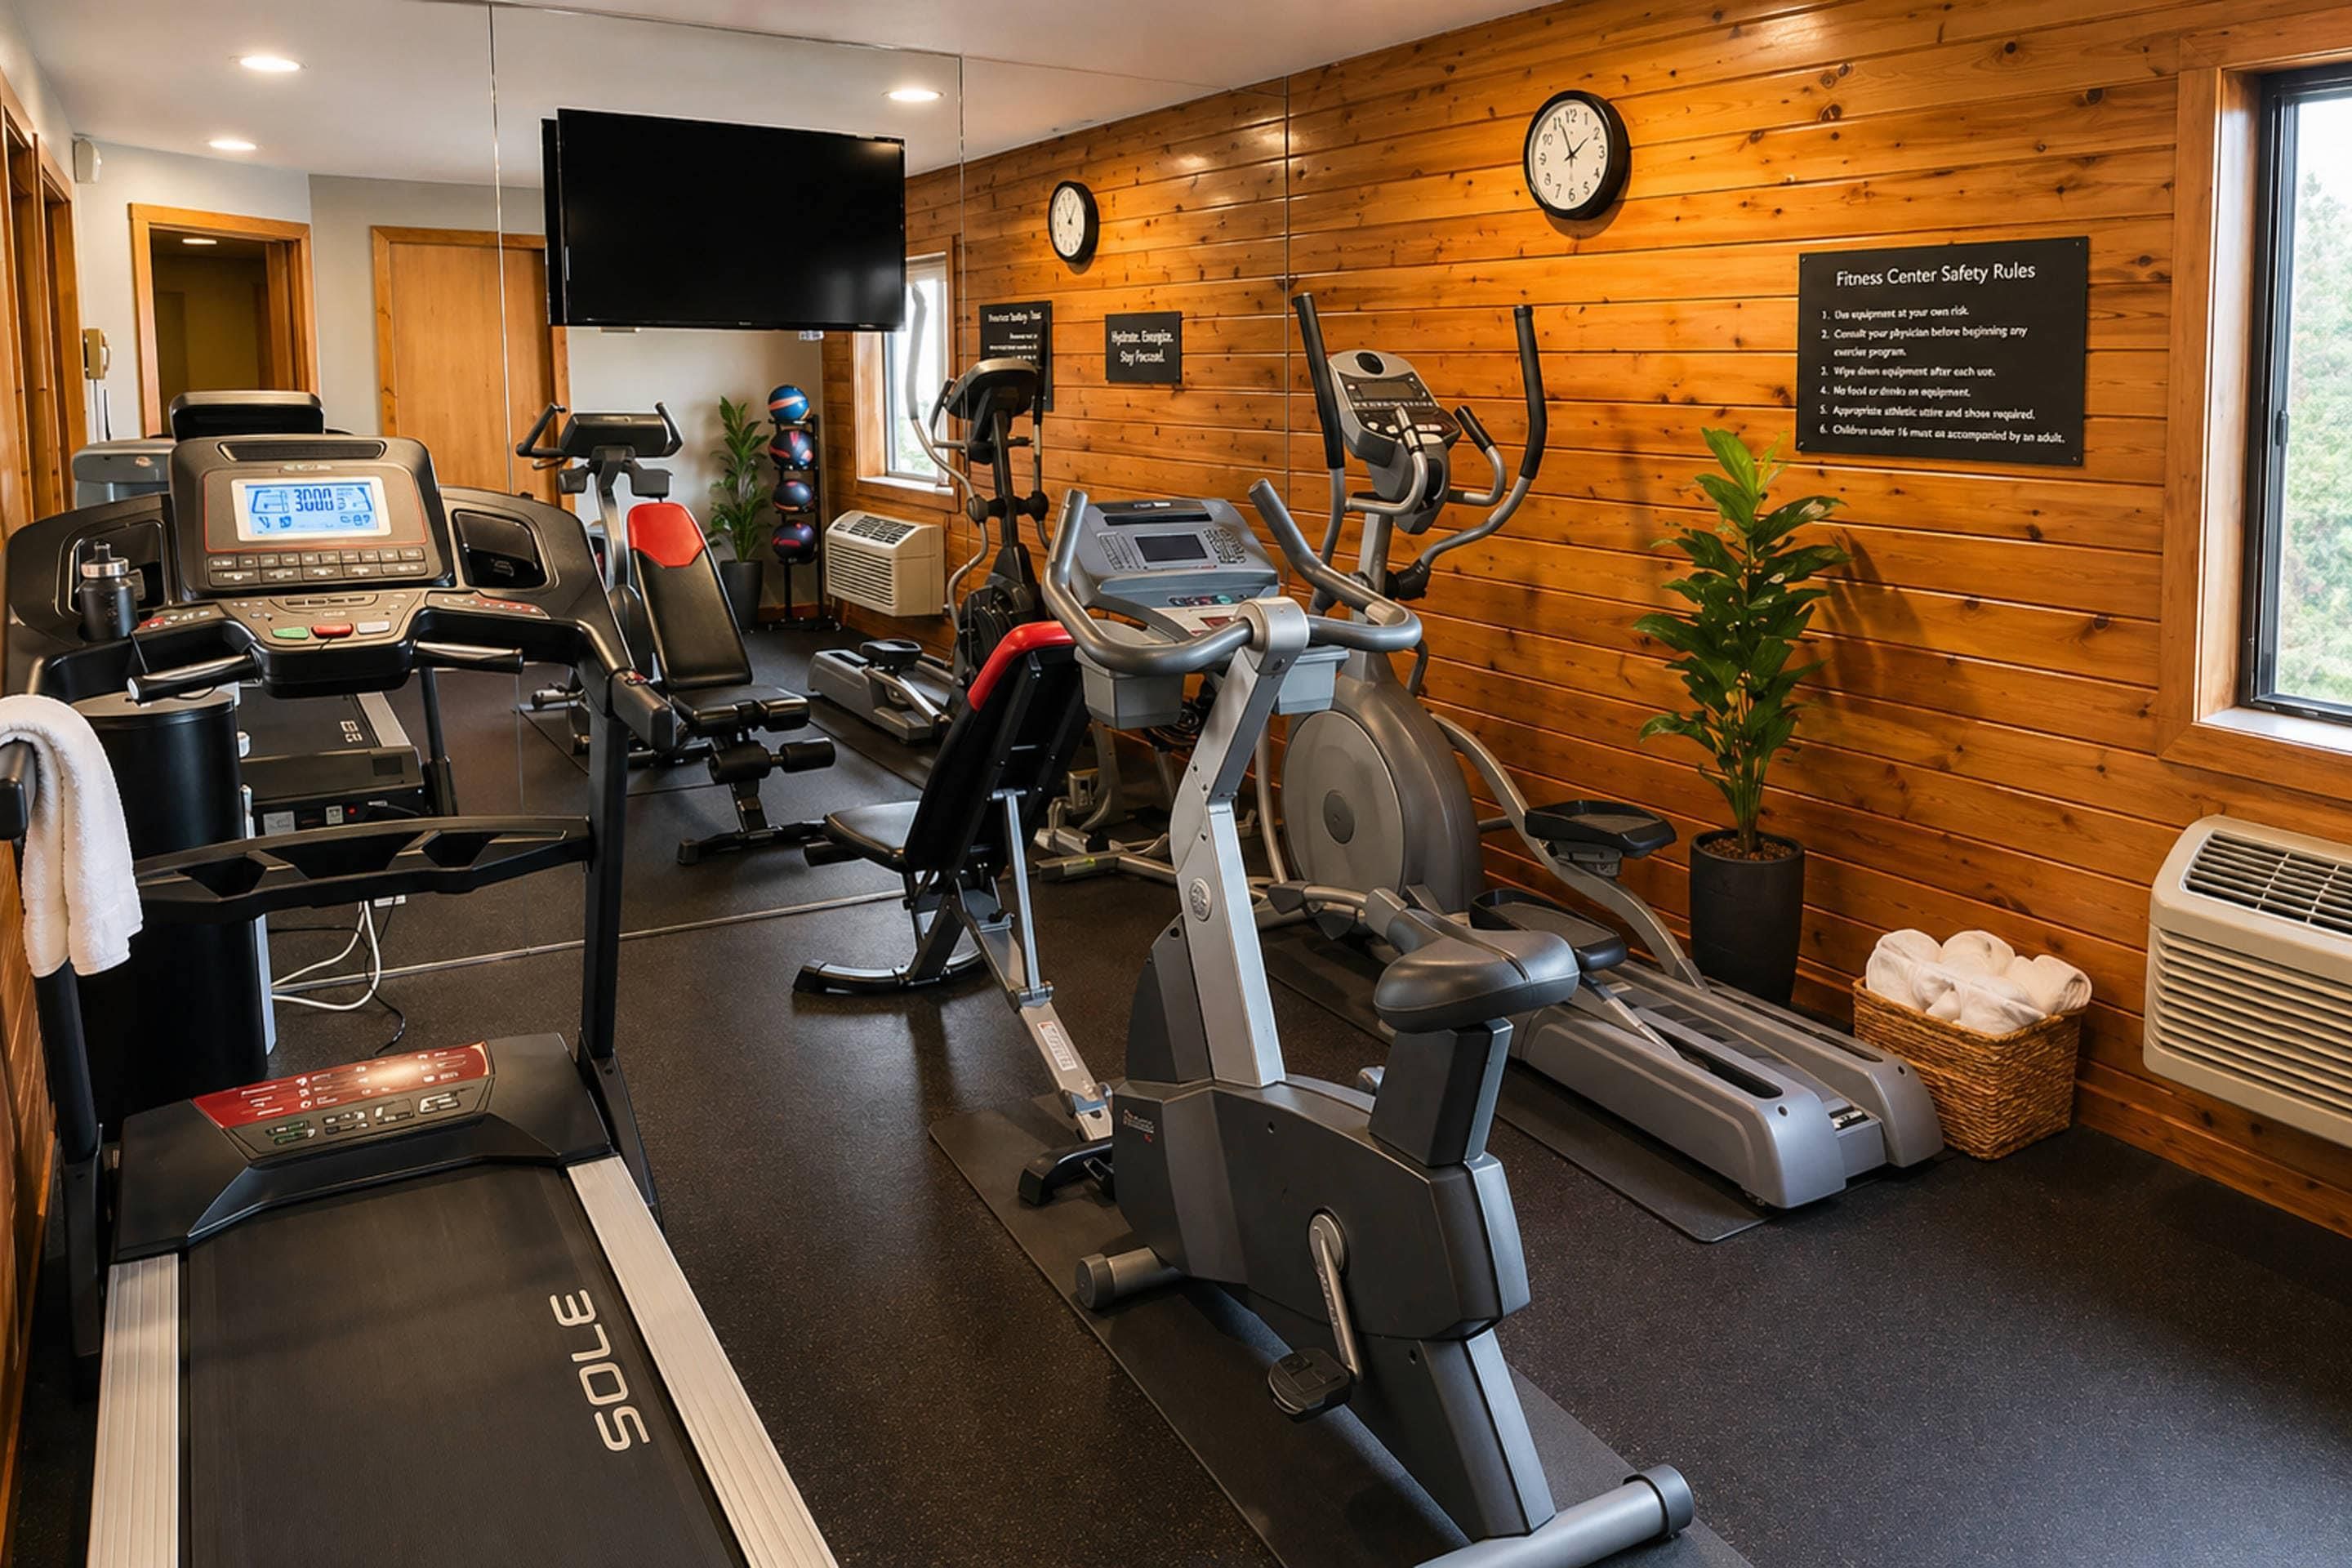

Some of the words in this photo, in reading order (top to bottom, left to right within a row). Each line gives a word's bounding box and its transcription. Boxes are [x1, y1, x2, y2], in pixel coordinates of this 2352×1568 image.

[1566, 109, 1577, 123] 12
[1584, 113, 1588, 125] 1
[1553, 117, 1561, 131] 11
[1593, 127, 1600, 140] 2
[1598, 145, 1606, 158] 3
[1539, 153, 1547, 165] 9
[1555, 184, 1561, 198] 7
[1569, 188, 1575, 202] 6
[1583, 181, 1590, 195] 5
[1837, 271, 1883, 286] Fitness
[1887, 268, 1937, 283] Center
[1941, 264, 1989, 284] Safety
[1993, 261, 2036, 278] Rules
[1822, 310, 1830, 319] 1.
[1851, 309, 1895, 321] equipment
[1909, 309, 1928, 319] your
[1950, 305, 1969, 315] risk.
[1820, 329, 1829, 339] 2.
[1869, 330, 1888, 340] your
[1890, 327, 1929, 340] physician
[1931, 327, 1960, 336] before
[1962, 325, 2007, 339] beginning
[2010, 327, 2028, 337] any
[1869, 348, 1906, 359] program.
[1833, 368, 1855, 378] Wipe
[1882, 368, 1927, 378] equipment
[1930, 367, 1952, 376] after
[1820, 385, 1829, 394] 4.
[1833, 386, 1846, 395] No
[1847, 385, 1867, 395] food
[1921, 387, 1971, 399] equipment.
[1820, 404, 1828, 414] 5.
[1833, 405, 1882, 417] Appropriate
[1884, 406, 1917, 416] athletic
[1944, 408, 1962, 417] and
[1993, 409, 2035, 421] required.
[1820, 424, 1828, 434] 6.
[1869, 426, 1895, 437] under
[1898, 427, 1909, 437] 16
[1947, 430, 2007, 443] accompanied
[2008, 430, 2022, 443] by
[2023, 433, 2034, 442] an
[2037, 433, 2065, 443] adult.
[550, 1289, 650, 1451] SOLE
